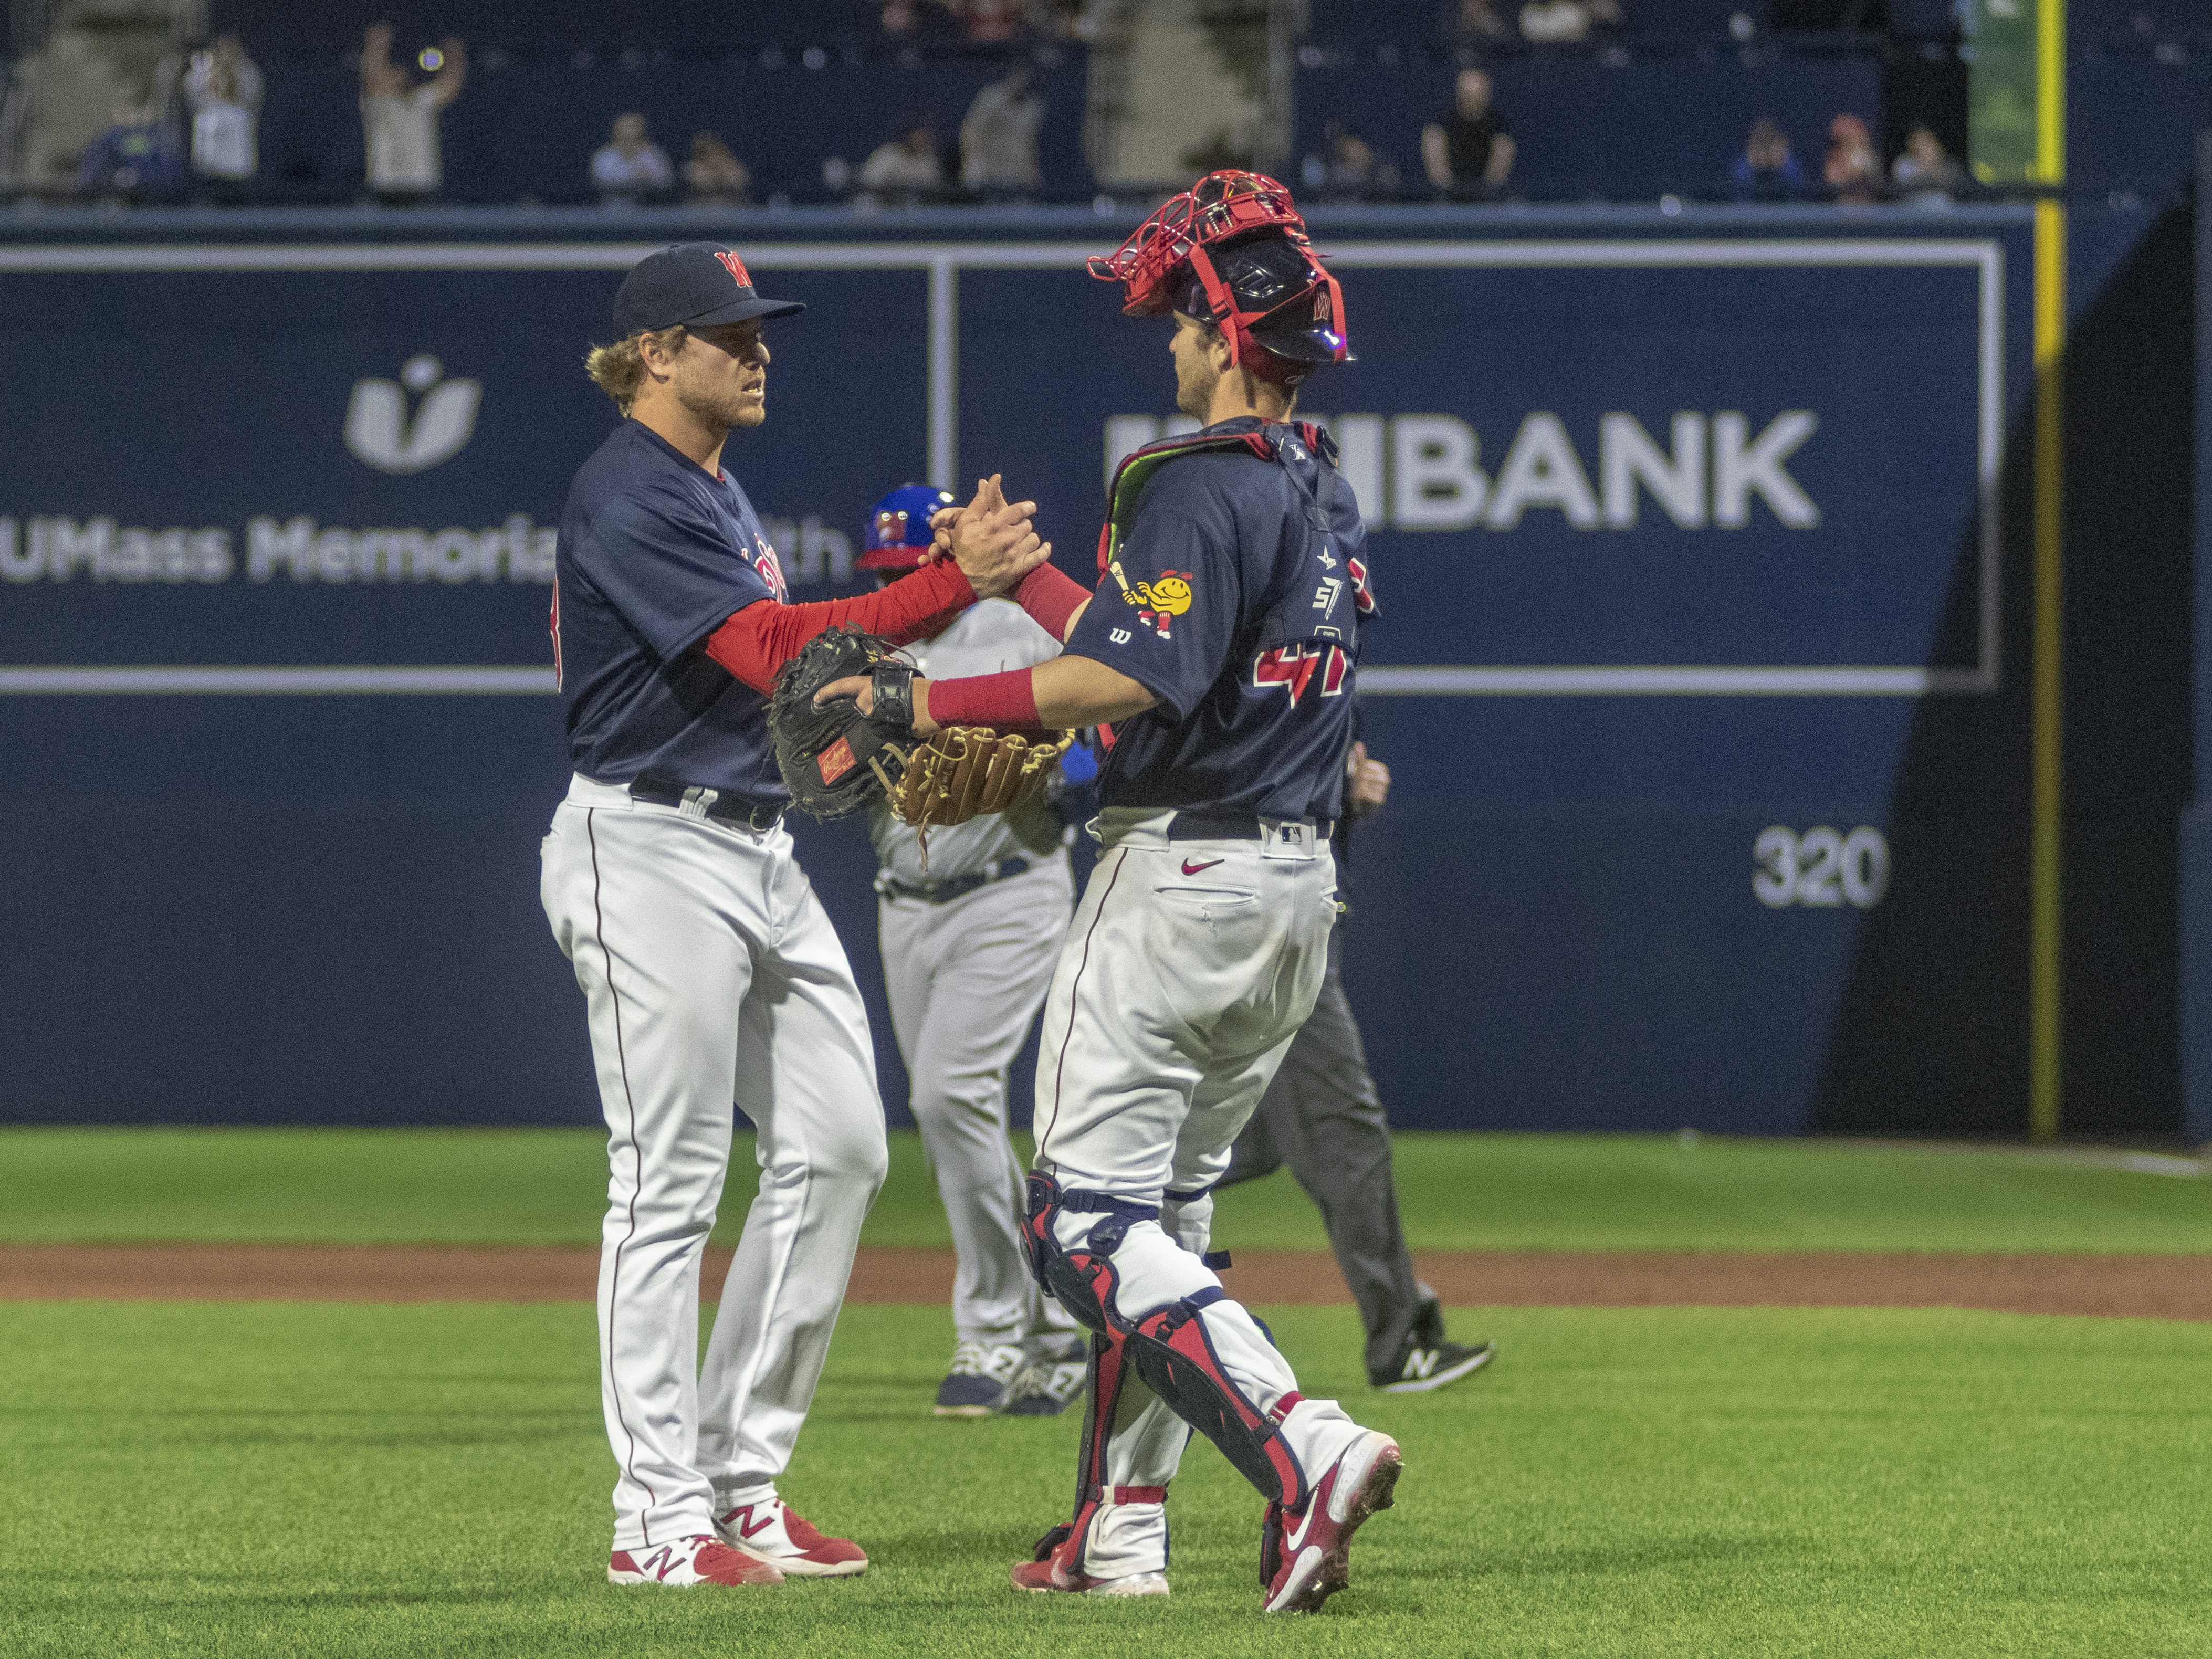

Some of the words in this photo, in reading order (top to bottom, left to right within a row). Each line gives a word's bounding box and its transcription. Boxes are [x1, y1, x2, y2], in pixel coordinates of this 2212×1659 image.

[1105, 412, 1816, 529] IBANK
[0, 516, 233, 582] UMass
[247, 514, 557, 582] Memoria
[1754, 826, 1889, 906] 320
